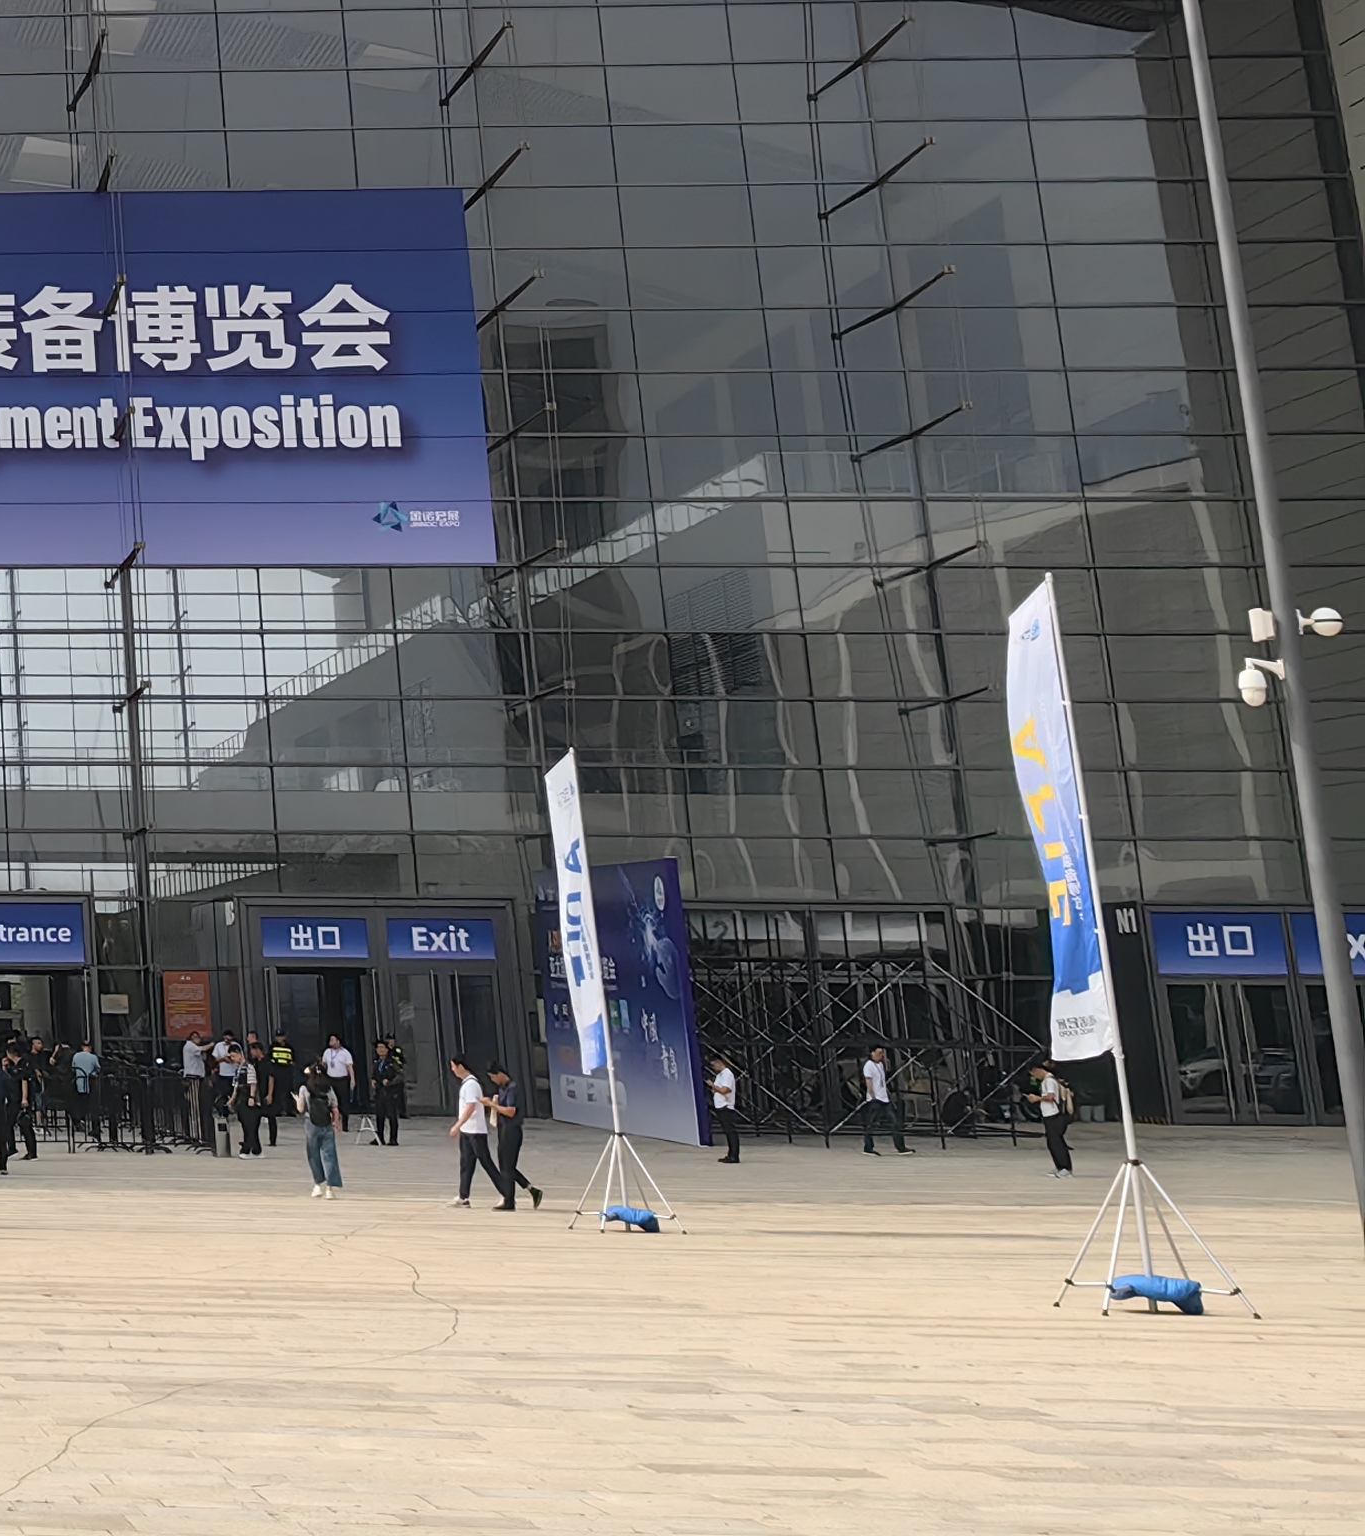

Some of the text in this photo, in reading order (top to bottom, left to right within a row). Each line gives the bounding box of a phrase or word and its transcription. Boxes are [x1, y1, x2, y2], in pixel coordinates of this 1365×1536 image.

[131, 394, 402, 461] Exposition
[1115, 907, 1138, 934] N1
[289, 925, 341, 951] 出口
[412, 925, 470, 952] Exit
[1186, 923, 1255, 957] 出口
